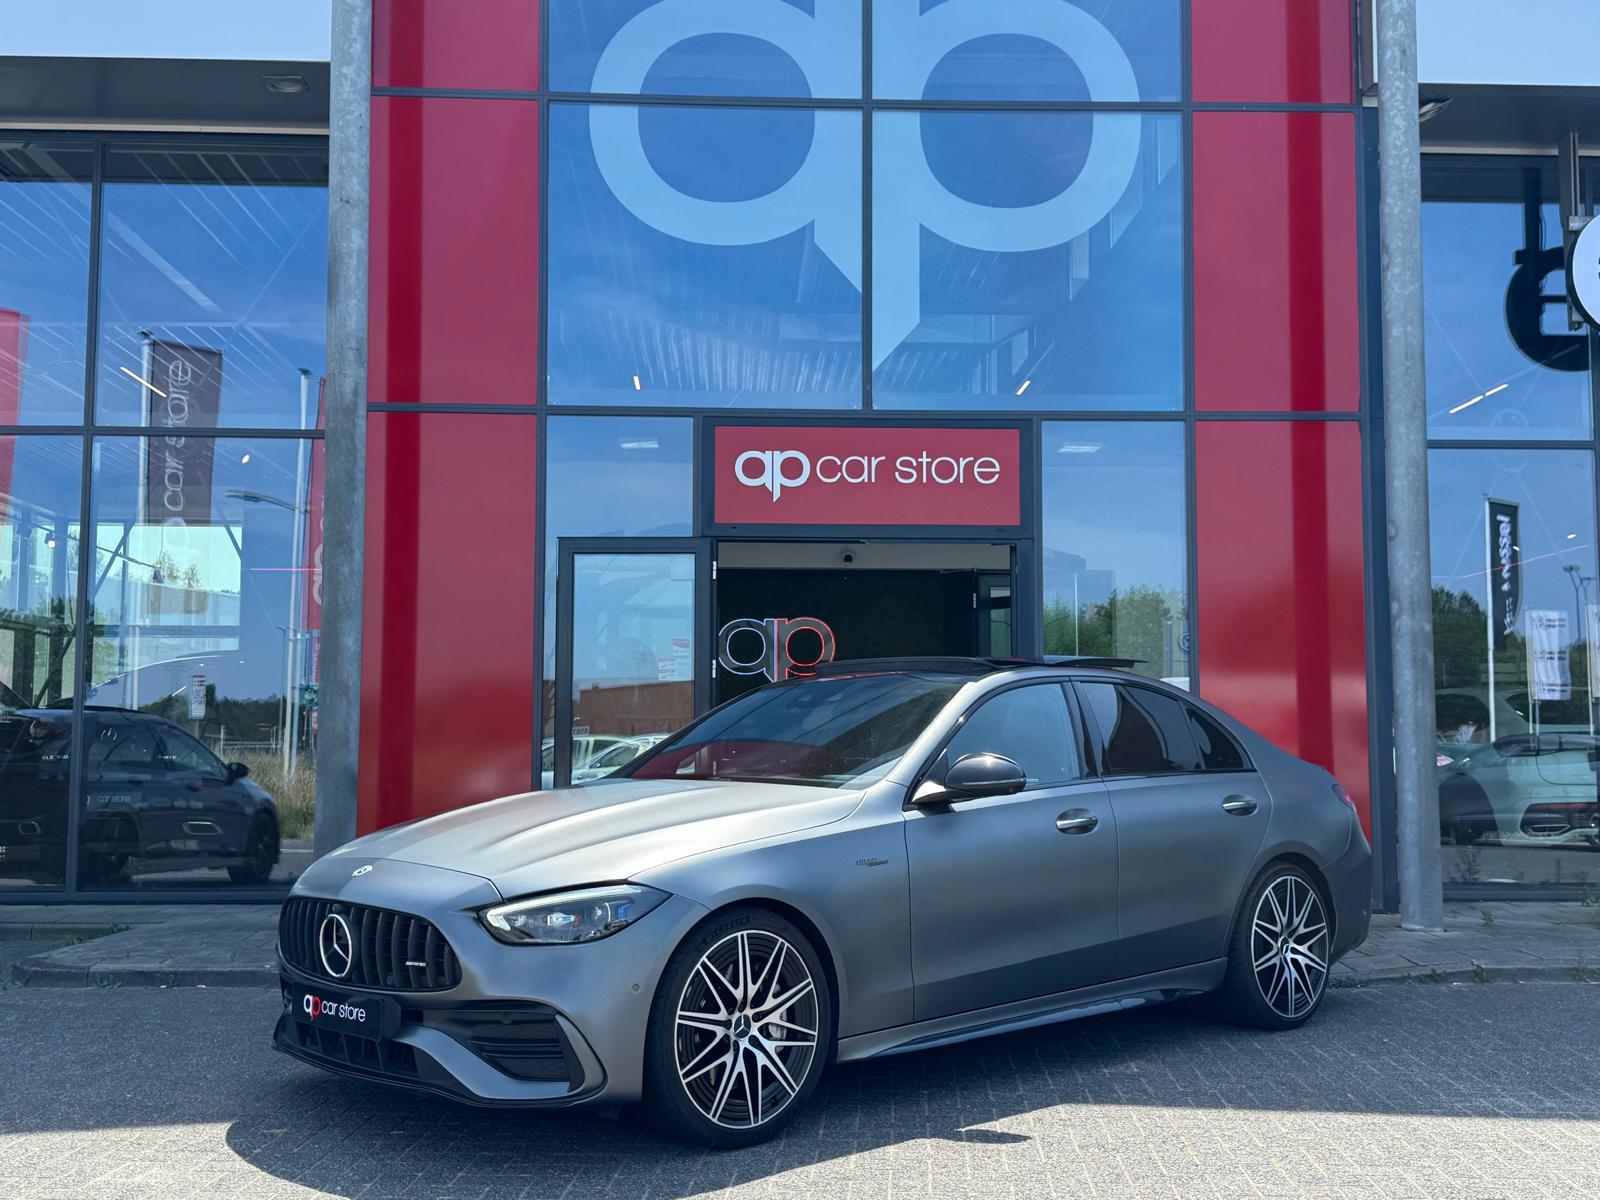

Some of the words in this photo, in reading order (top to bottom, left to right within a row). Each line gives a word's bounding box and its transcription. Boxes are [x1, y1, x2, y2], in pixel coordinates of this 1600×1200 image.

[163, 450, 184, 511] car
[816, 455, 885, 484] car
[895, 449, 1000, 486] store
[321, 1000, 338, 1016] car
[338, 1003, 366, 1022] store
